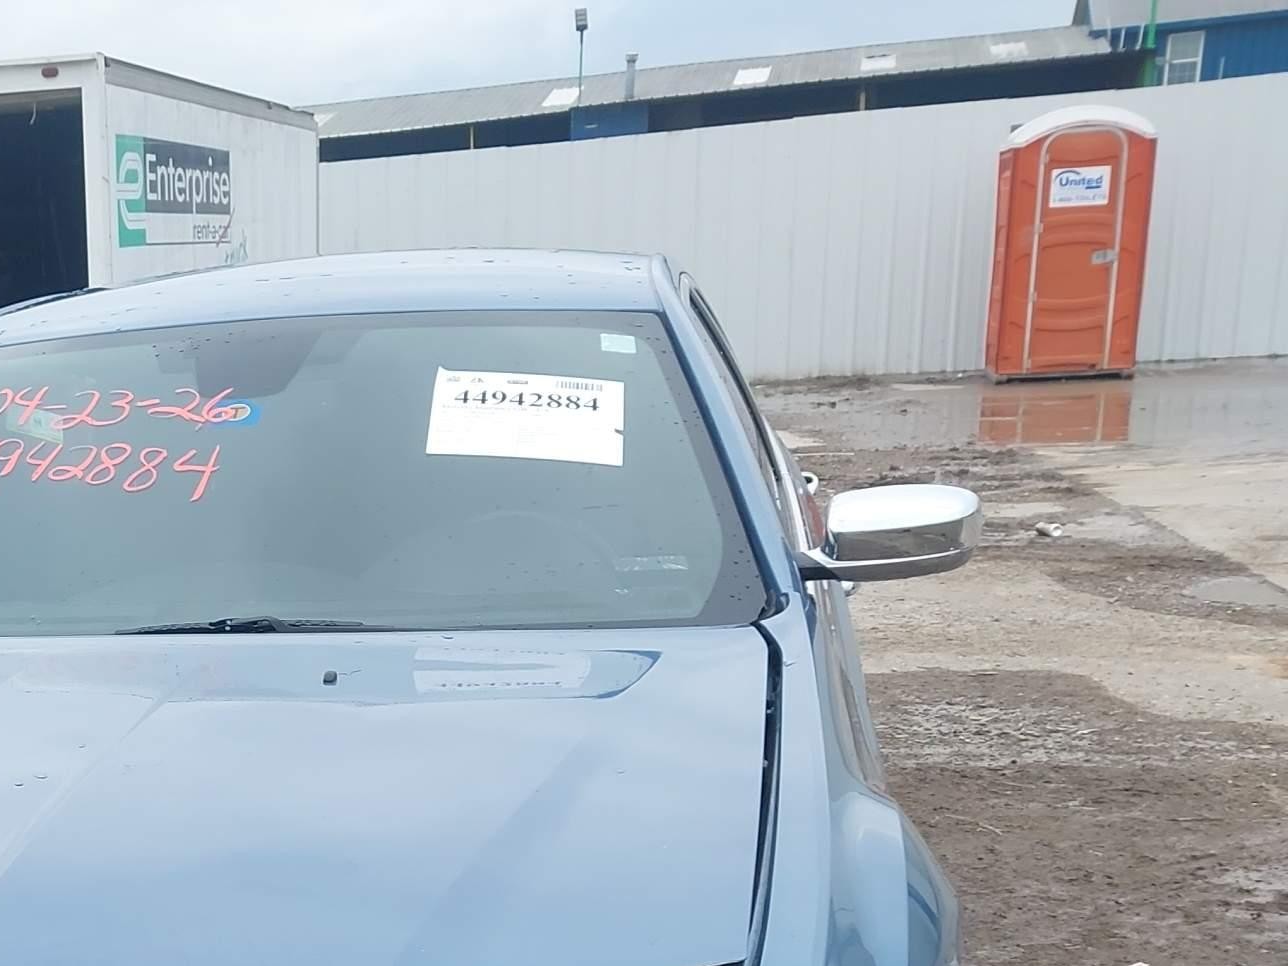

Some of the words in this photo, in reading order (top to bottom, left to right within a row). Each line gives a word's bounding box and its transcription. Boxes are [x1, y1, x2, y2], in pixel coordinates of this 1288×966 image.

[146, 154, 230, 214] Enterprise
[1059, 175, 1103, 187] United
[454, 389, 600, 412] 44942884
